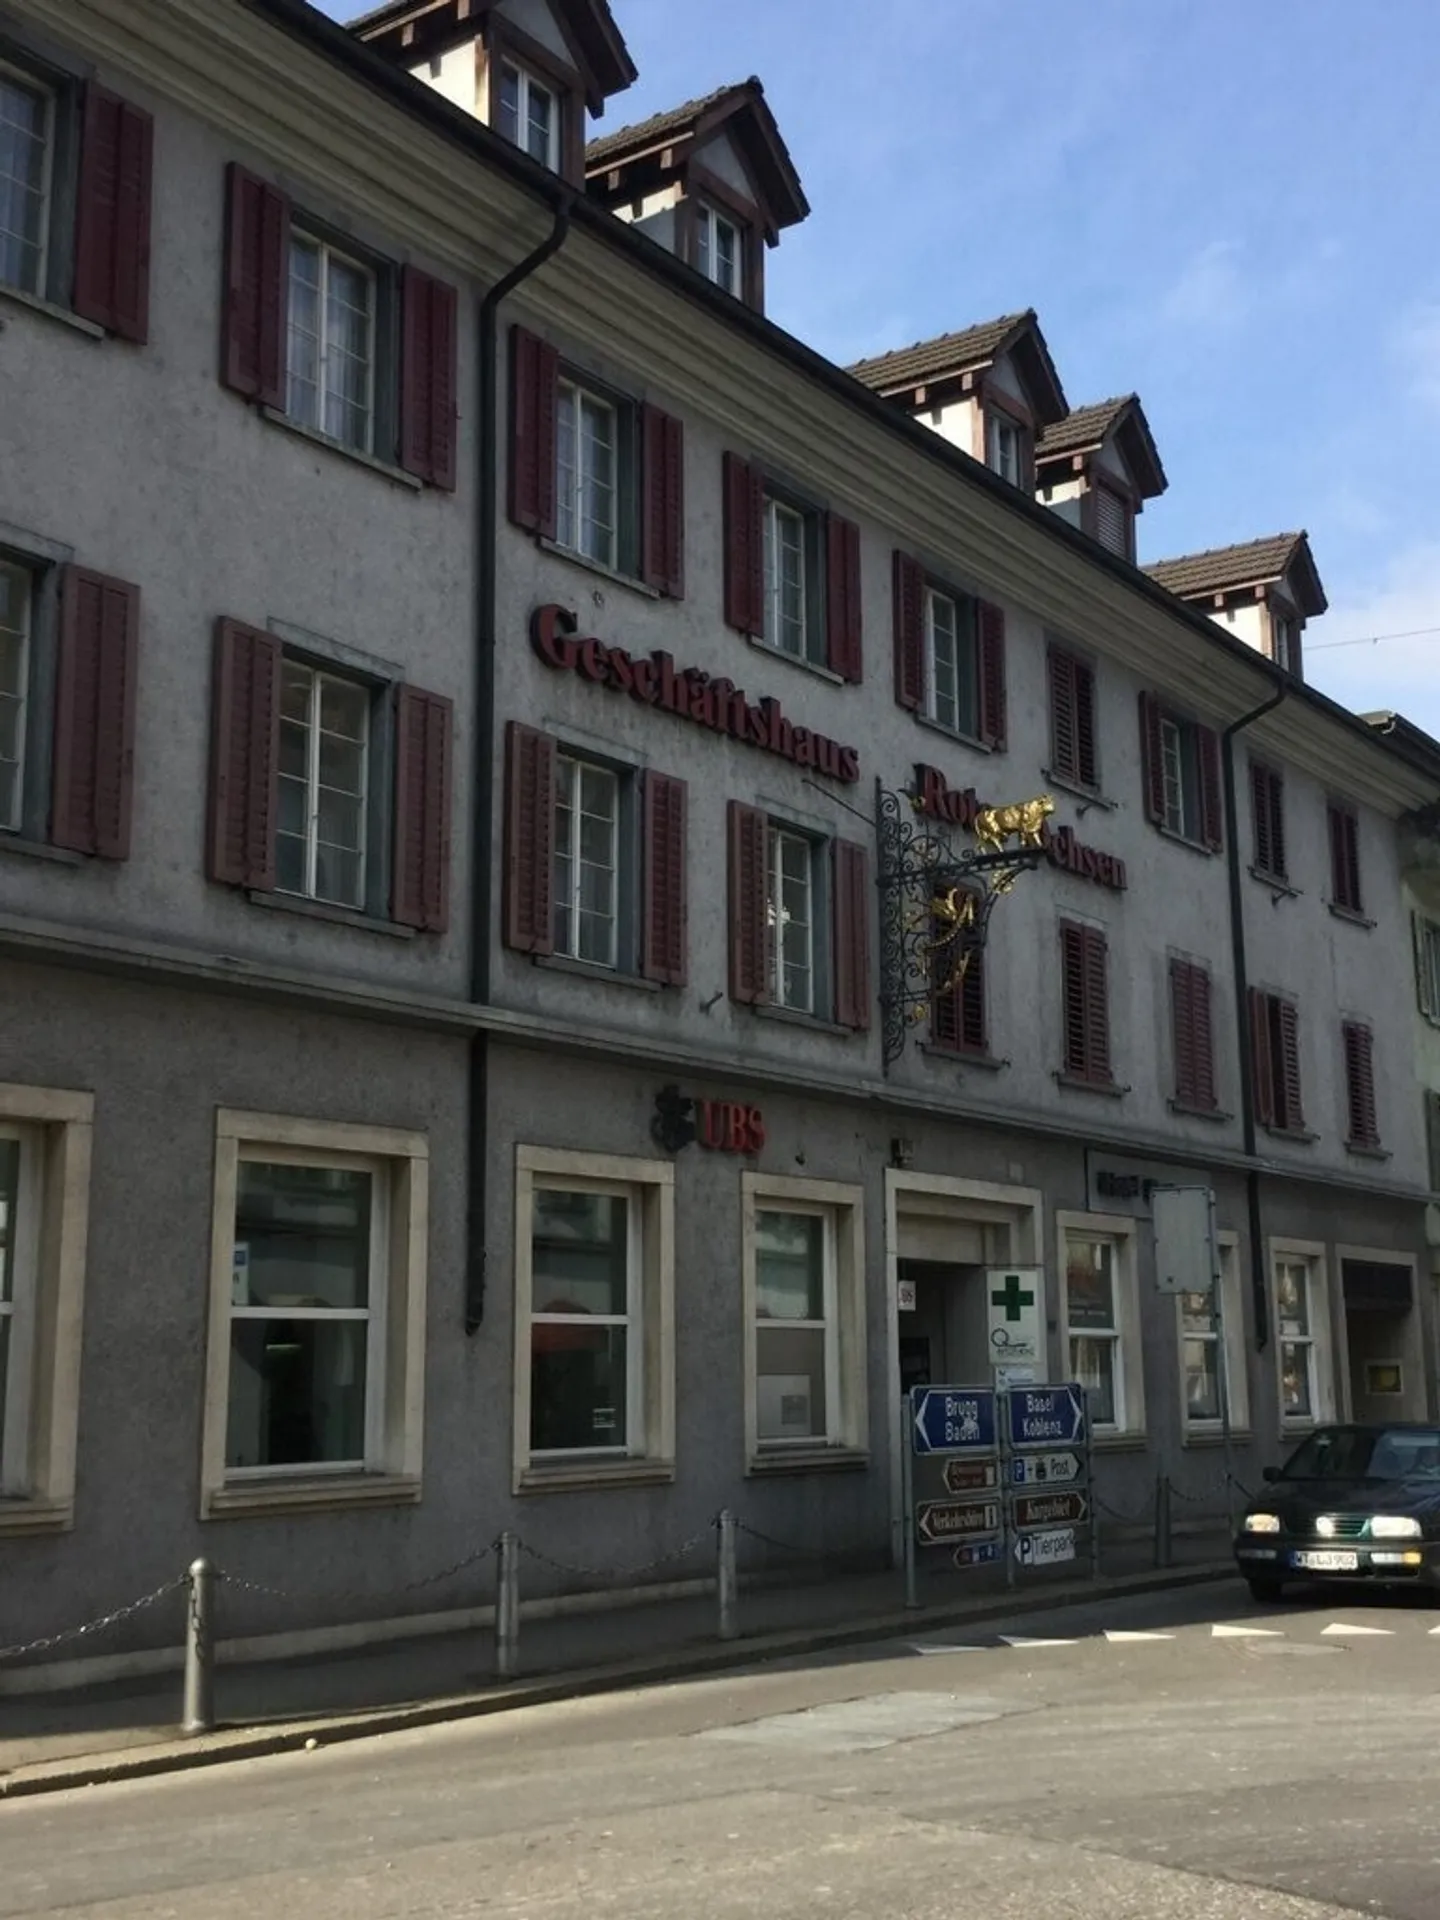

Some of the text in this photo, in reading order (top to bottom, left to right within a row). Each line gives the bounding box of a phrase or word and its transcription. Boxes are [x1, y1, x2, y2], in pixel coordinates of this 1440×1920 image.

[530, 603, 860, 783] Geschäftshaus
[697, 1098, 768, 1155] UBS
[945, 1397, 978, 1420] Brugg
[1026, 1393, 1055, 1412] Basel
[1022, 1417, 1063, 1437] Koblenz
[1021, 1537, 1031, 1564] P
